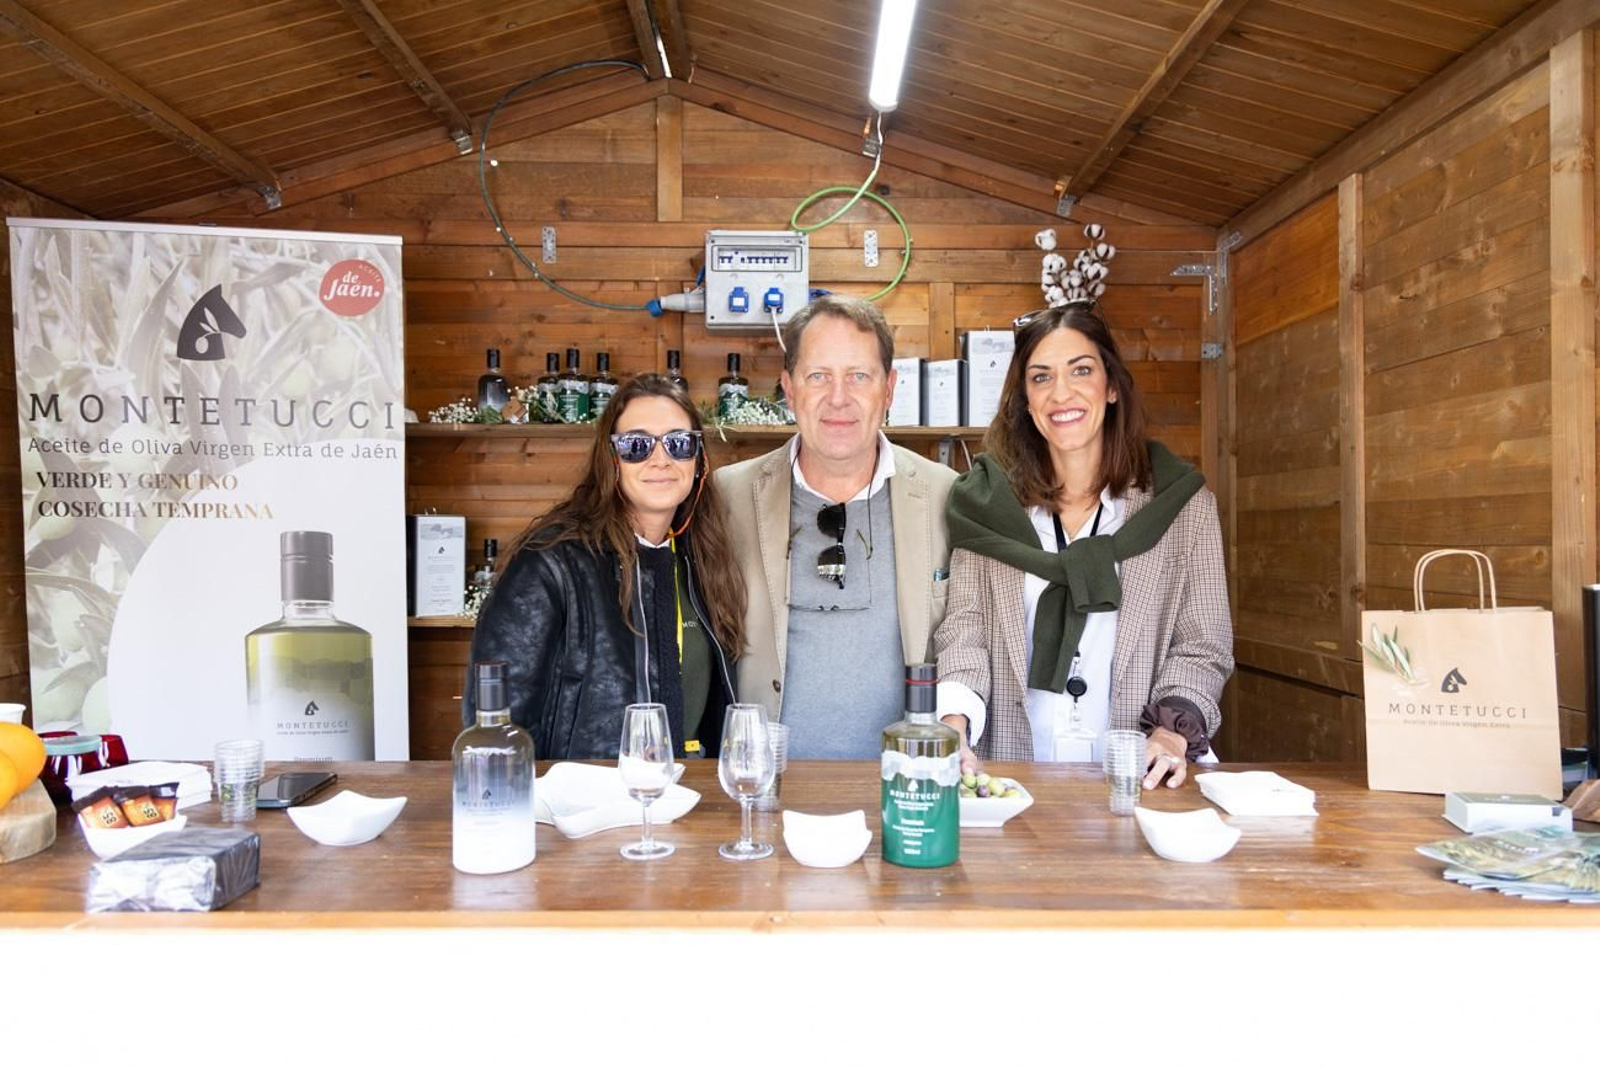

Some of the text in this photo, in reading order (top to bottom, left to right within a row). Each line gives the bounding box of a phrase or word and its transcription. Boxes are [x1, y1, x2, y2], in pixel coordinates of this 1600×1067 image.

[342, 270, 359, 284] de
[29, 393, 394, 429] MONTETUCCI
[28, 437, 397, 460] Aceite de Oliva Virgen Extra de Jaén
[36, 471, 238, 490] VERDE Y GENUINO
[37, 500, 274, 519] COSECHA TEMPRANA
[1388, 703, 1526, 719] MONTETUCCI
[276, 720, 348, 729] MONTETUCCI
